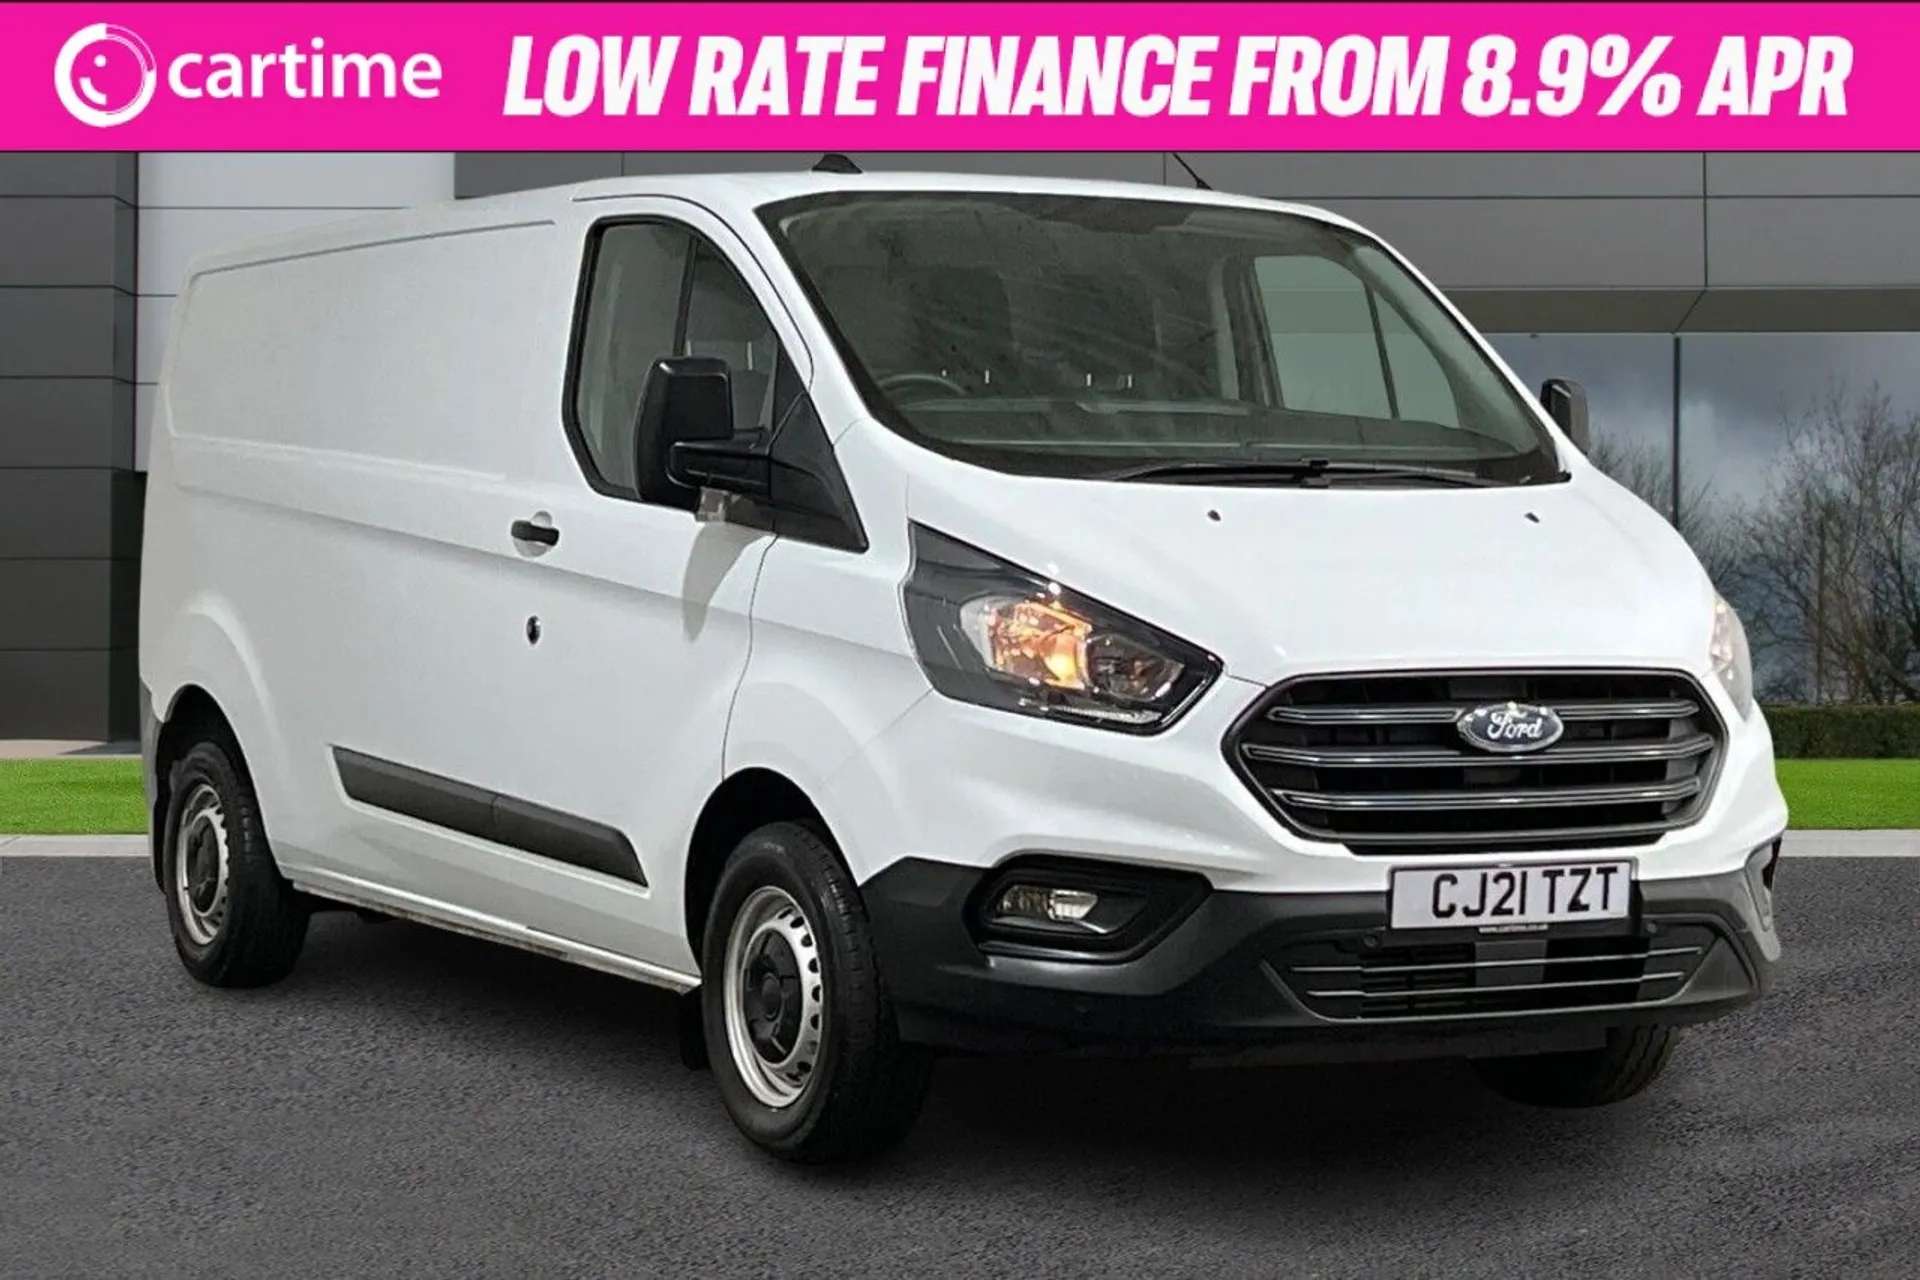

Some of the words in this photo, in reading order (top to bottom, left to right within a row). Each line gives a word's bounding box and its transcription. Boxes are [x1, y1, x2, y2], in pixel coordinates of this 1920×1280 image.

[1487, 709, 1543, 739] Ford
[1432, 871, 1527, 918] CJ21
[1542, 866, 1618, 914] TZT
